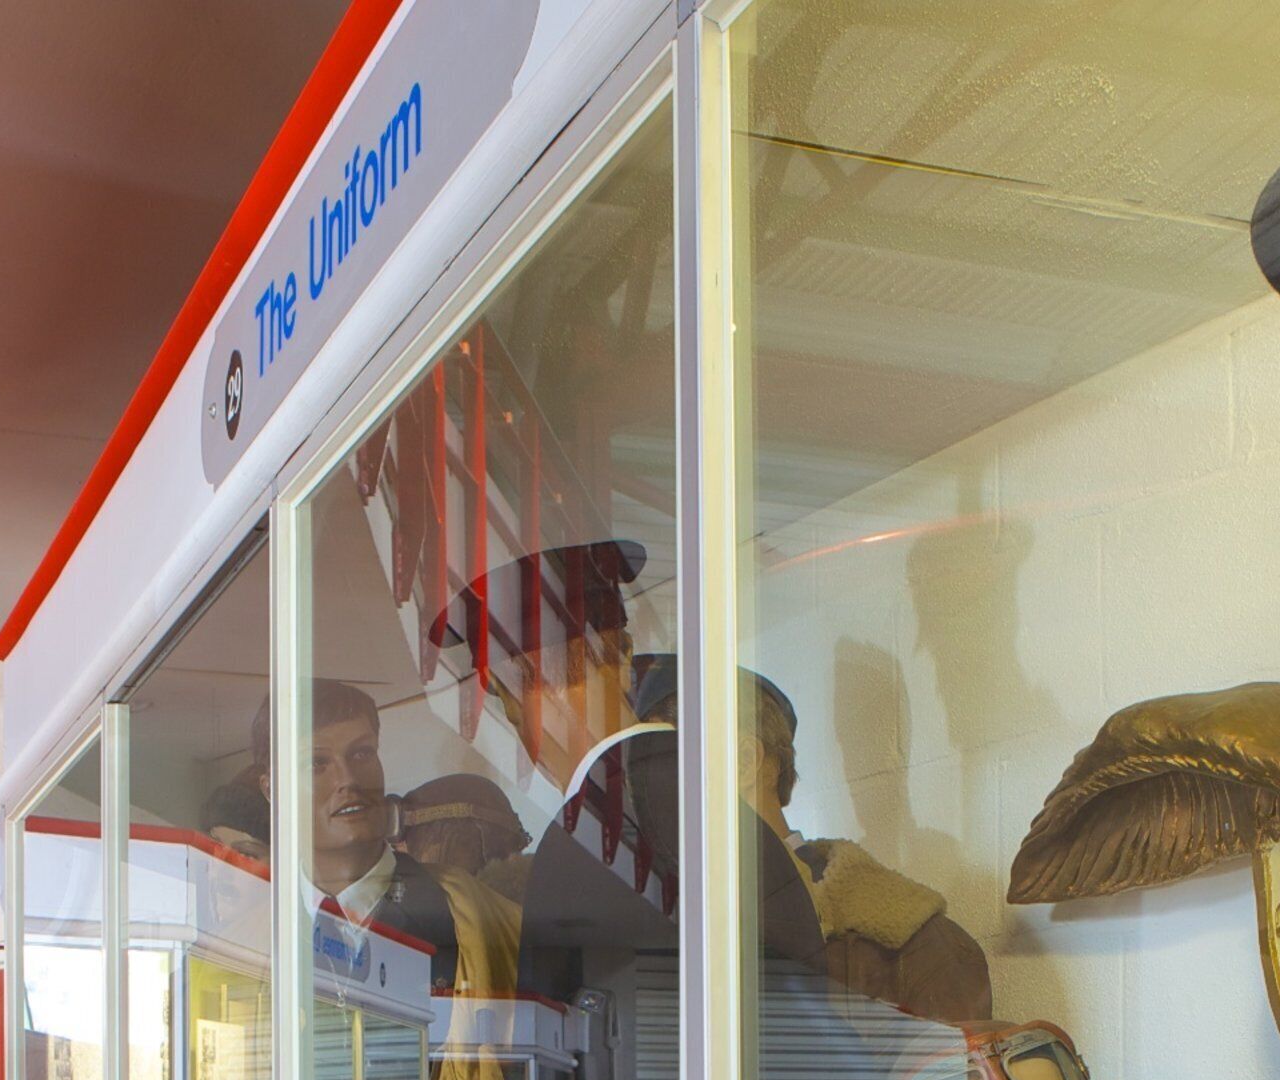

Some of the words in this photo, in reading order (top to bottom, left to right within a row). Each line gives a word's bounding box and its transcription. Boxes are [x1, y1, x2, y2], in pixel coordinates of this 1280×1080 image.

[255, 271, 297, 377] The
[309, 82, 422, 301] Uniform
[227, 366, 241, 421] 29
